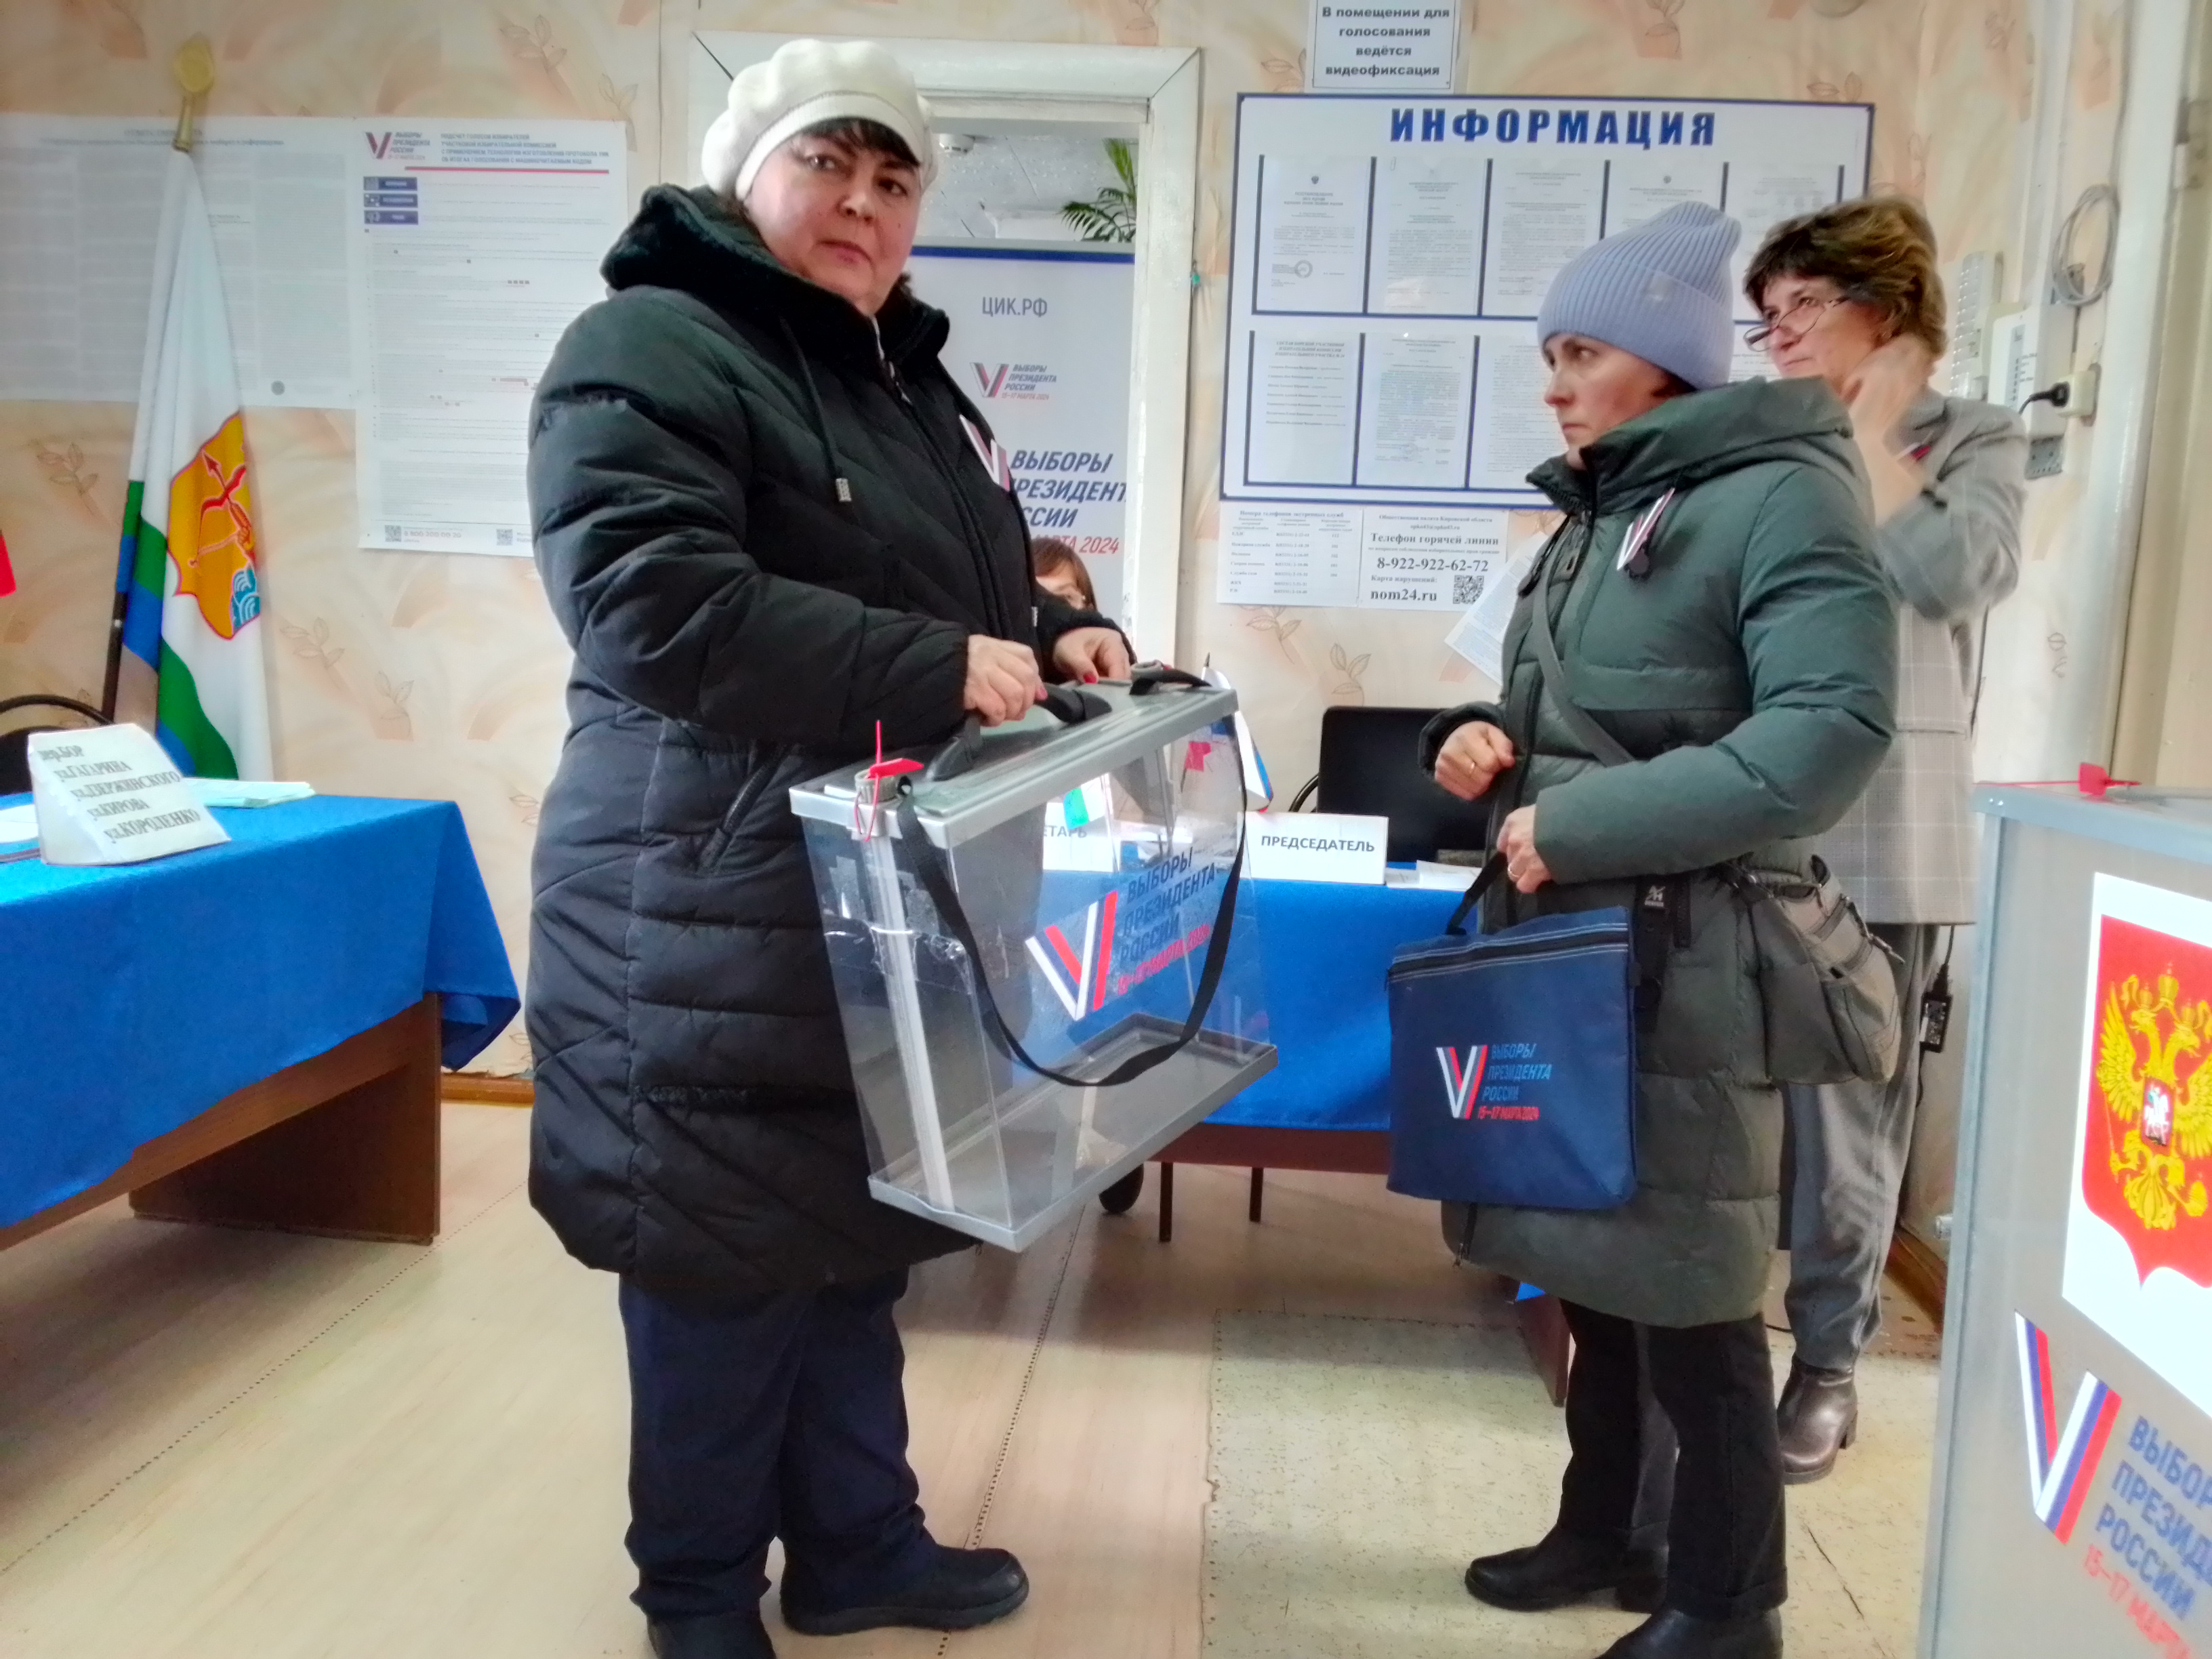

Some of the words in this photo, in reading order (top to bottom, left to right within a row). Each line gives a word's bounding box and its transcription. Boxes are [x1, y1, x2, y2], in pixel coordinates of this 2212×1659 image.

[1322, 7, 1332, 18] В
[1336, 9, 1420, 19] помещении
[1424, 9, 1450, 19] для
[1339, 28, 1431, 37] голосования
[1356, 45, 1412, 57] ведётся
[1326, 64, 1439, 77] видеофиксация
[1390, 108, 1716, 150] ИНФОРМАЦИЯ
[982, 296, 1048, 317] ЦИК.РФ
[1012, 364, 1047, 372] ВЫБОРЫ
[1008, 373, 1057, 383] ПРЕЗИДЕНТА
[1004, 383, 1036, 391] РОССИИ
[1010, 450, 1113, 474] ВЫБОРЫ
[1013, 478, 1127, 504] РЕЗИДЕНТ
[1078, 536, 1120, 554] 2024
[1371, 533, 1416, 545] Телефон
[1419, 535, 1462, 546] горячей
[1465, 537, 1499, 546] линии
[1377, 556, 1489, 572] 8-922-922-62-72
[1371, 589, 1437, 602] nom24.ru
[1261, 835, 1375, 853] ПРЕДСЕДАТЕЛЬ
[1127, 846, 1193, 905] ВЫБОРЫ
[1122, 862, 1215, 938] ПРЕЗИДЕНТА
[1120, 912, 1180, 967] РОССИИ
[1492, 1043, 1537, 1059] ВЫБОРЫ
[1488, 1064, 1552, 1082] ПРЕЗИДЕНТА
[1482, 1086, 1519, 1101] РОССИИ
[2128, 1414, 2212, 1511] ВЫБОР
[2095, 1502, 2196, 1620] РОССИИ
